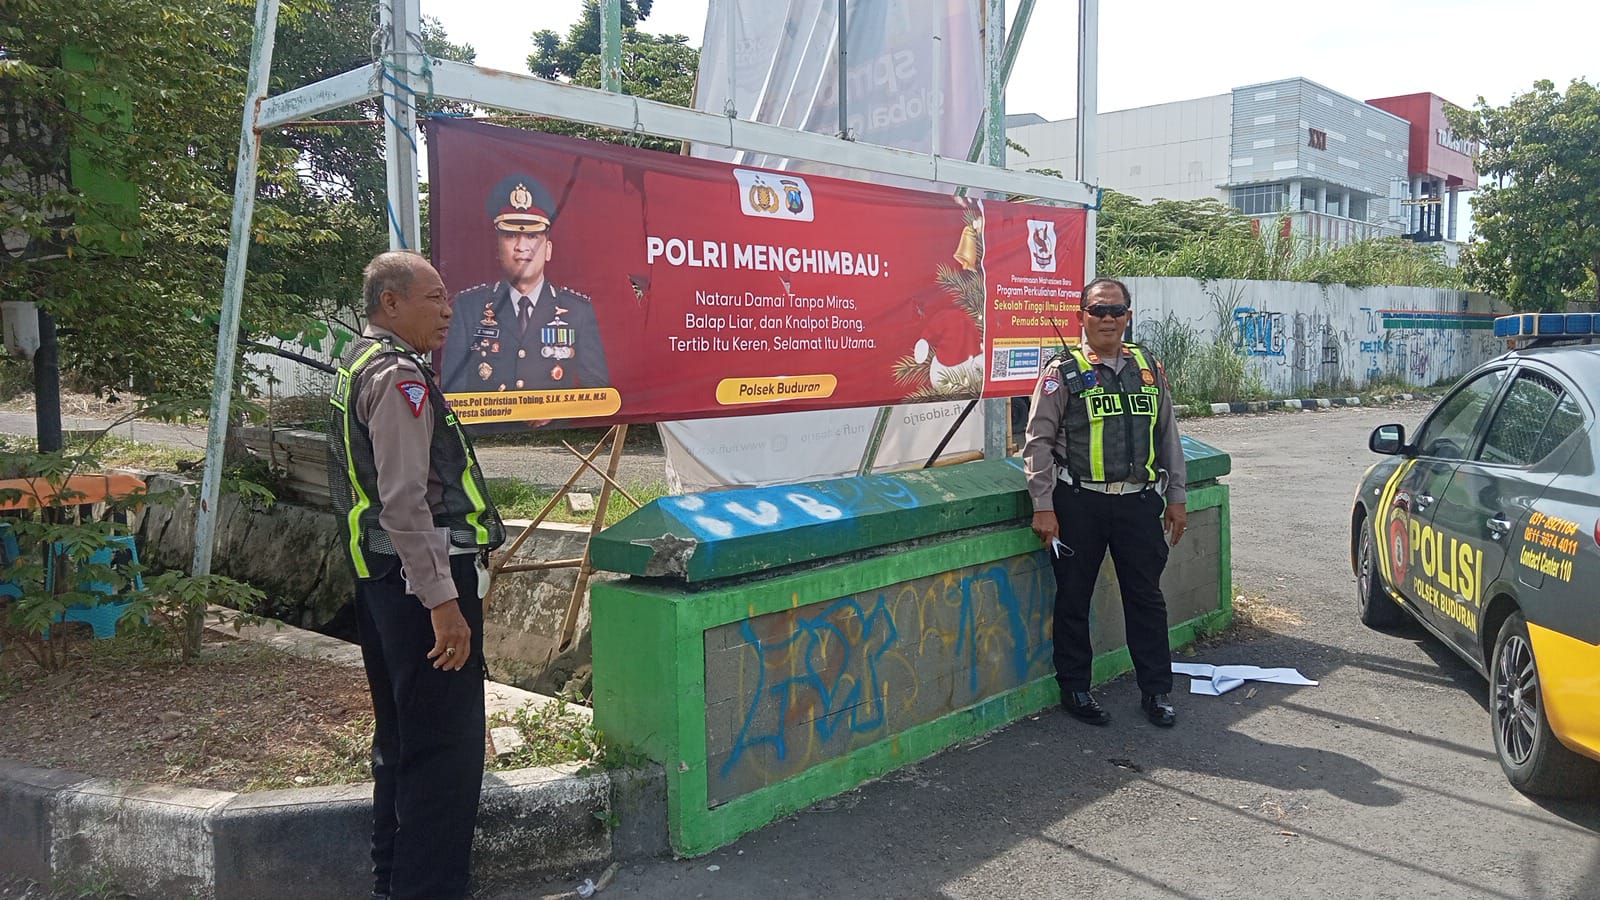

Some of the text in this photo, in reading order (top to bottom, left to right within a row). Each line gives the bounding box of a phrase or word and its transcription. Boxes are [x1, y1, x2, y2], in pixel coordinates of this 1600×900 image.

[1308, 127, 1328, 151] XXI
[647, 236, 727, 268] POLRI
[733, 243, 880, 277] MENGHIMBAU
[996, 284, 1023, 297] Program
[1024, 285, 1057, 297] Perkuliahan
[695, 290, 857, 311] Nataru Damai Tanpa Miras,
[993, 299, 1081, 313] Sekolah Tinggi Ilmu Ekonom
[685, 313, 865, 333] Balap Liar, dan Knalpot Brong.
[1011, 315, 1039, 326] Pemuda
[668, 335, 876, 352] Tertib Itu Keren, Selamat Itu Utama.
[739, 381, 820, 397] Polsek Buduran
[447, 397, 482, 408] mbes.Pol
[483, 396, 518, 406] Christian
[1091, 394, 1154, 415] POL ISI
[456, 408, 512, 418] lresta Sidoarjo
[1558, 537, 1579, 556] 4011
[1409, 518, 1483, 608] POLISI
[1519, 544, 1573, 583] Contact Center 110
[1413, 576, 1478, 634] POLSEK BUDURAN
